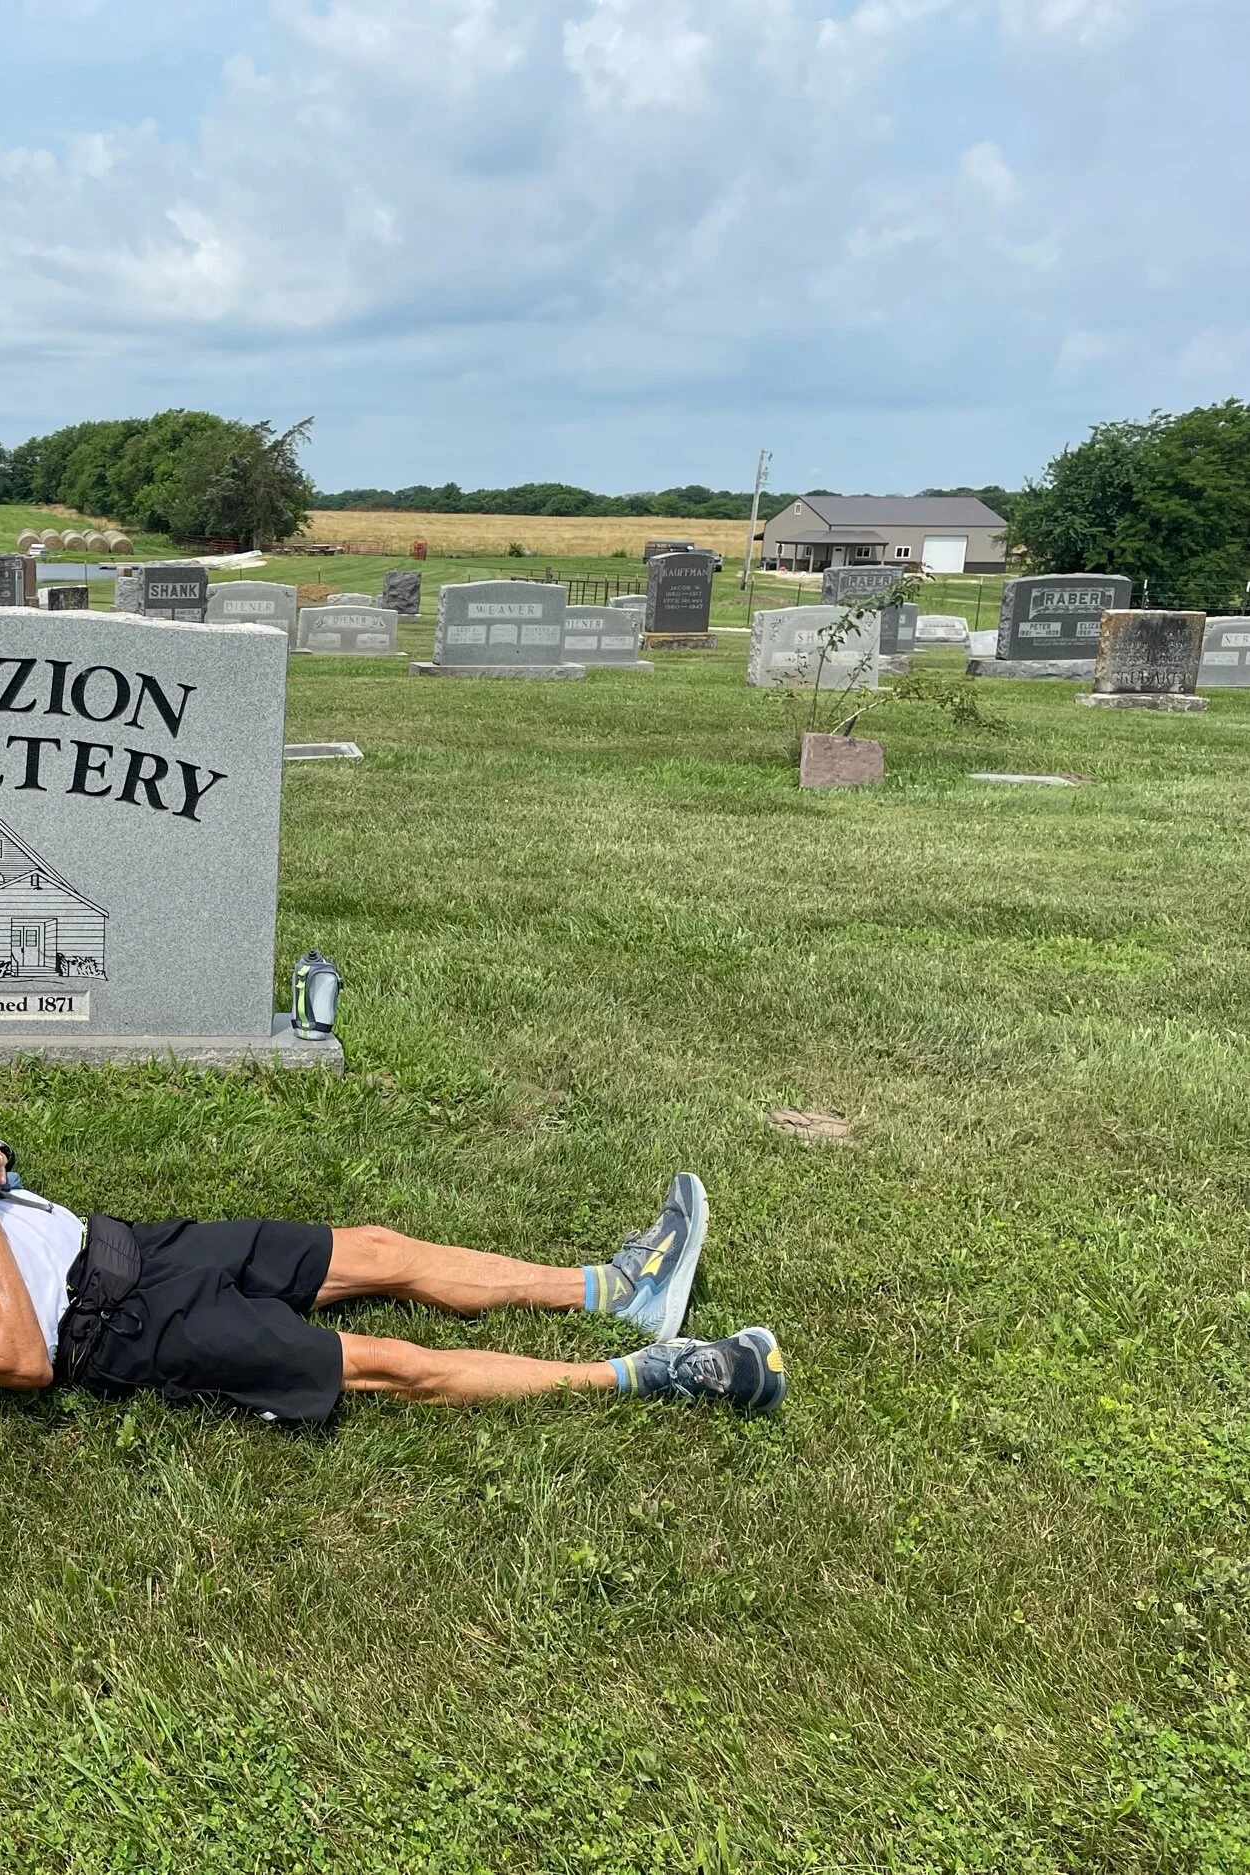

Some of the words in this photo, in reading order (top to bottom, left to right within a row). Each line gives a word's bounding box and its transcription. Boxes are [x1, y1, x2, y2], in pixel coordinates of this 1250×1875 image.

[662, 567, 708, 577] KAUFFMAN
[850, 575, 889, 586] RABER
[150, 584, 198, 598] SHANK
[1045, 592, 1100, 605] RABER
[225, 602, 272, 612] DIENER
[476, 605, 535, 615] WEAVER
[333, 616, 367, 624] DIENER
[38, 996, 74, 1013] 1871
